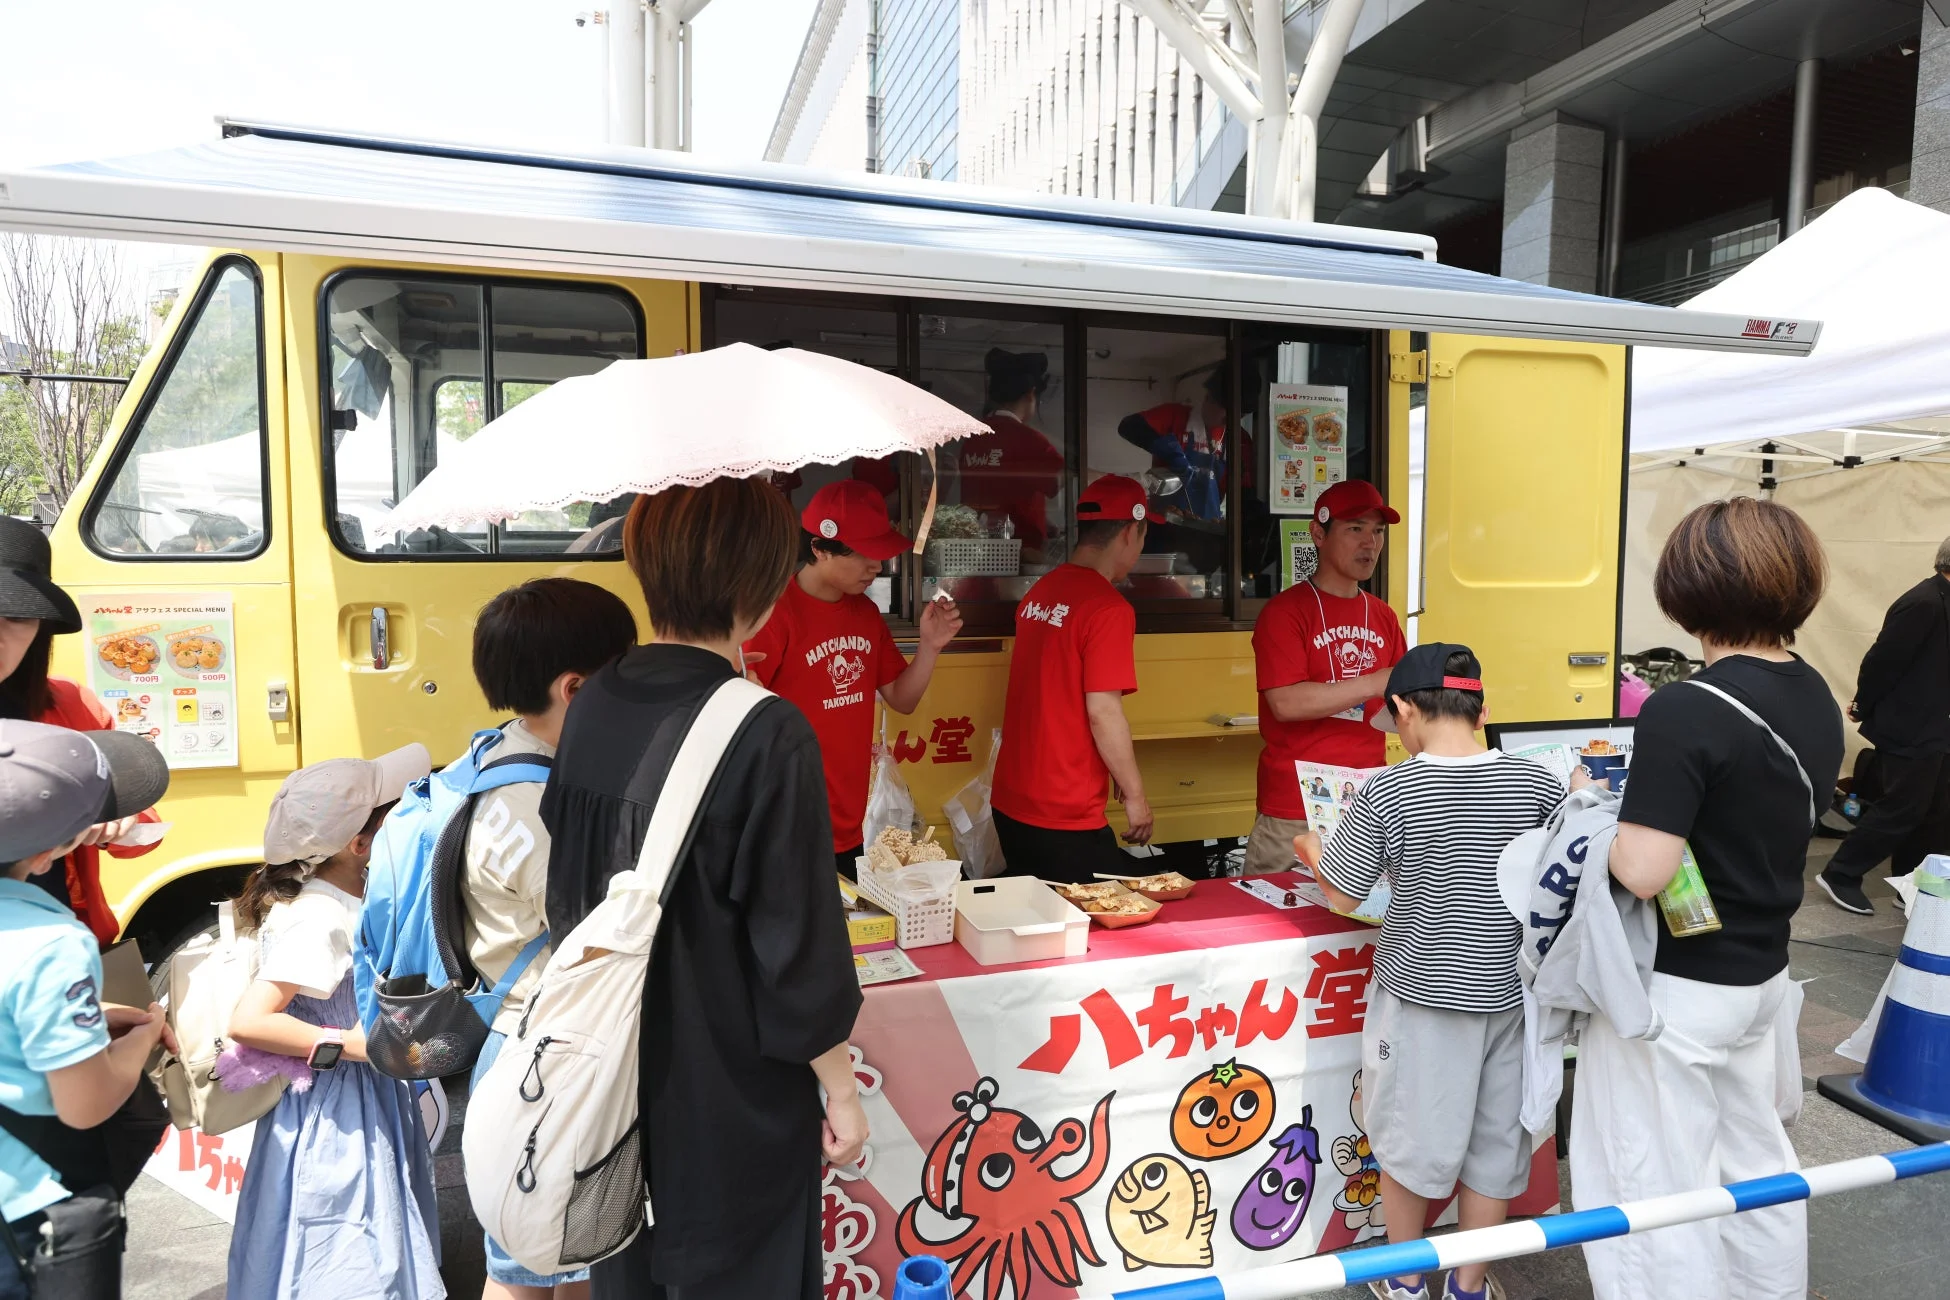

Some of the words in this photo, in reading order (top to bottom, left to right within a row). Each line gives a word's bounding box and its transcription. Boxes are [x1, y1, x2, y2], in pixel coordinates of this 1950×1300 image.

[94, 606, 133, 614] 八ちゃん堂
[1020, 601, 1070, 628] 八ちゃん堂
[806, 635, 872, 667] HATCHANDO
[1313, 625, 1385, 650] HATCHANDO
[823, 692, 864, 710] TAKOYAKI
[876, 716, 976, 765] ん堂
[65, 974, 102, 1028] 3
[1017, 942, 1377, 1074] 八ちゃん堂
